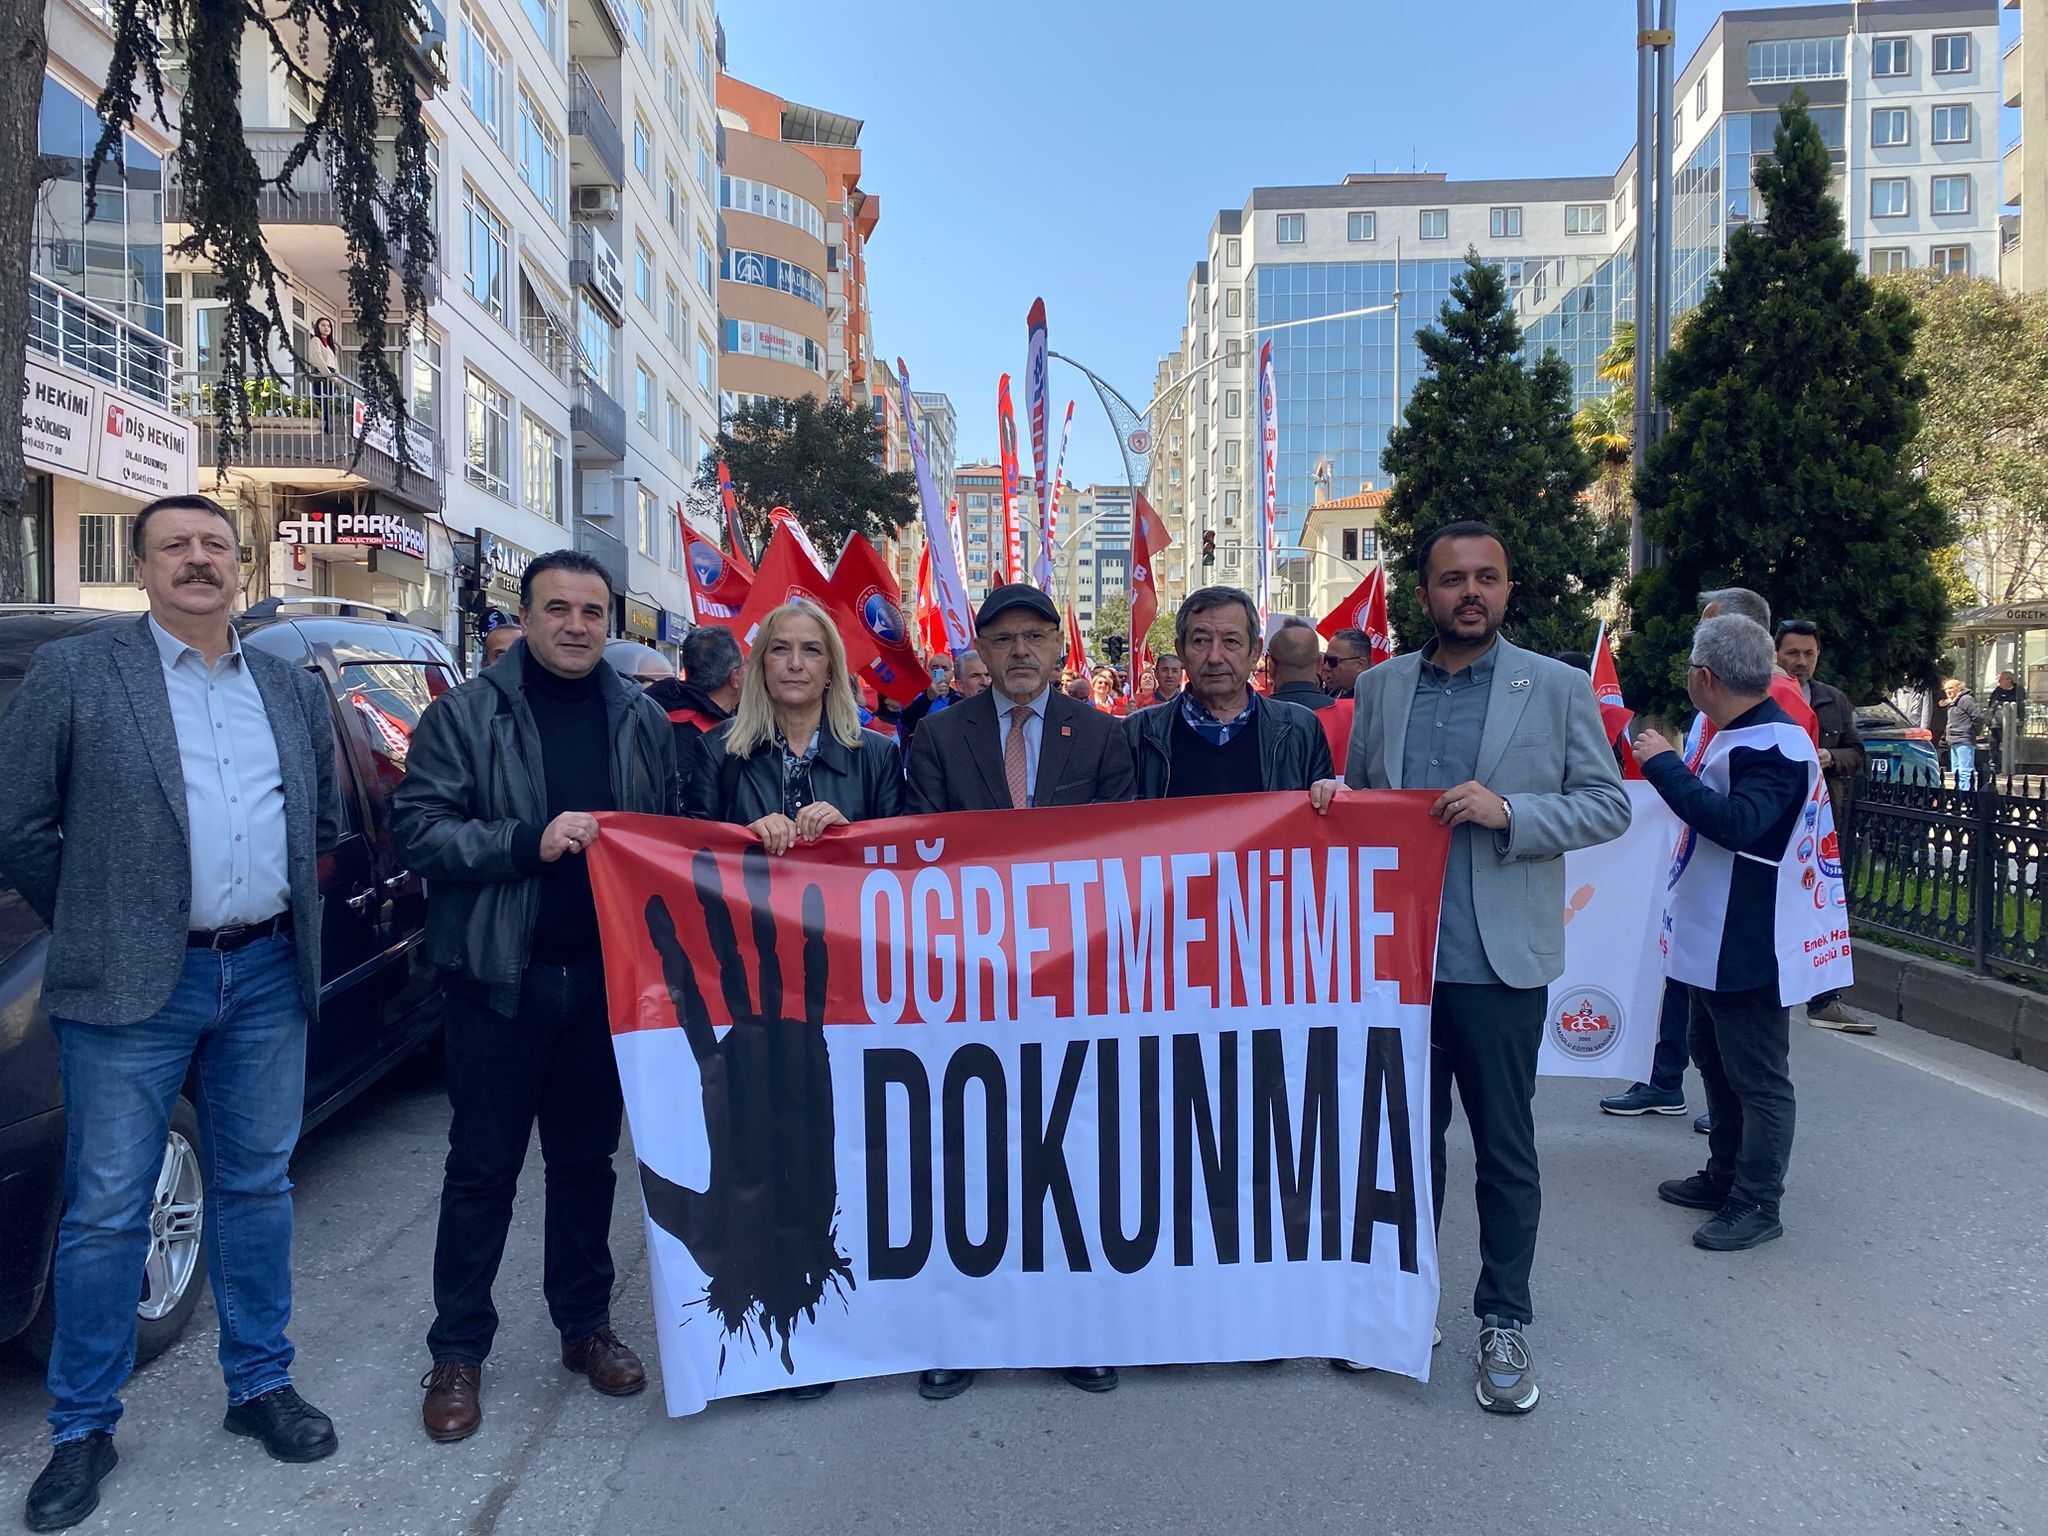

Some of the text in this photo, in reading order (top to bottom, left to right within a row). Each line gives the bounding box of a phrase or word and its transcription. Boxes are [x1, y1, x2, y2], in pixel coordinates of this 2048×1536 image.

[35, 381, 88, 417] HEKİMİ
[34, 415, 72, 442] SÖKMEN
[125, 416, 185, 456] DİŞ HEKİMİ
[143, 455, 168, 475] DURMUŞ
[337, 514, 402, 534] PARK
[338, 536, 383, 544] COLLECTION
[860, 837, 1402, 1026] ÖĞRETMENİME
[1803, 934, 1829, 953] Emek
[1813, 946, 1837, 968] Güçlü
[1555, 1022, 1573, 1049] ANADOLU
[1571, 1044, 1594, 1053] EĞİTİM
[863, 1026, 1419, 1282] DOKUNMA
